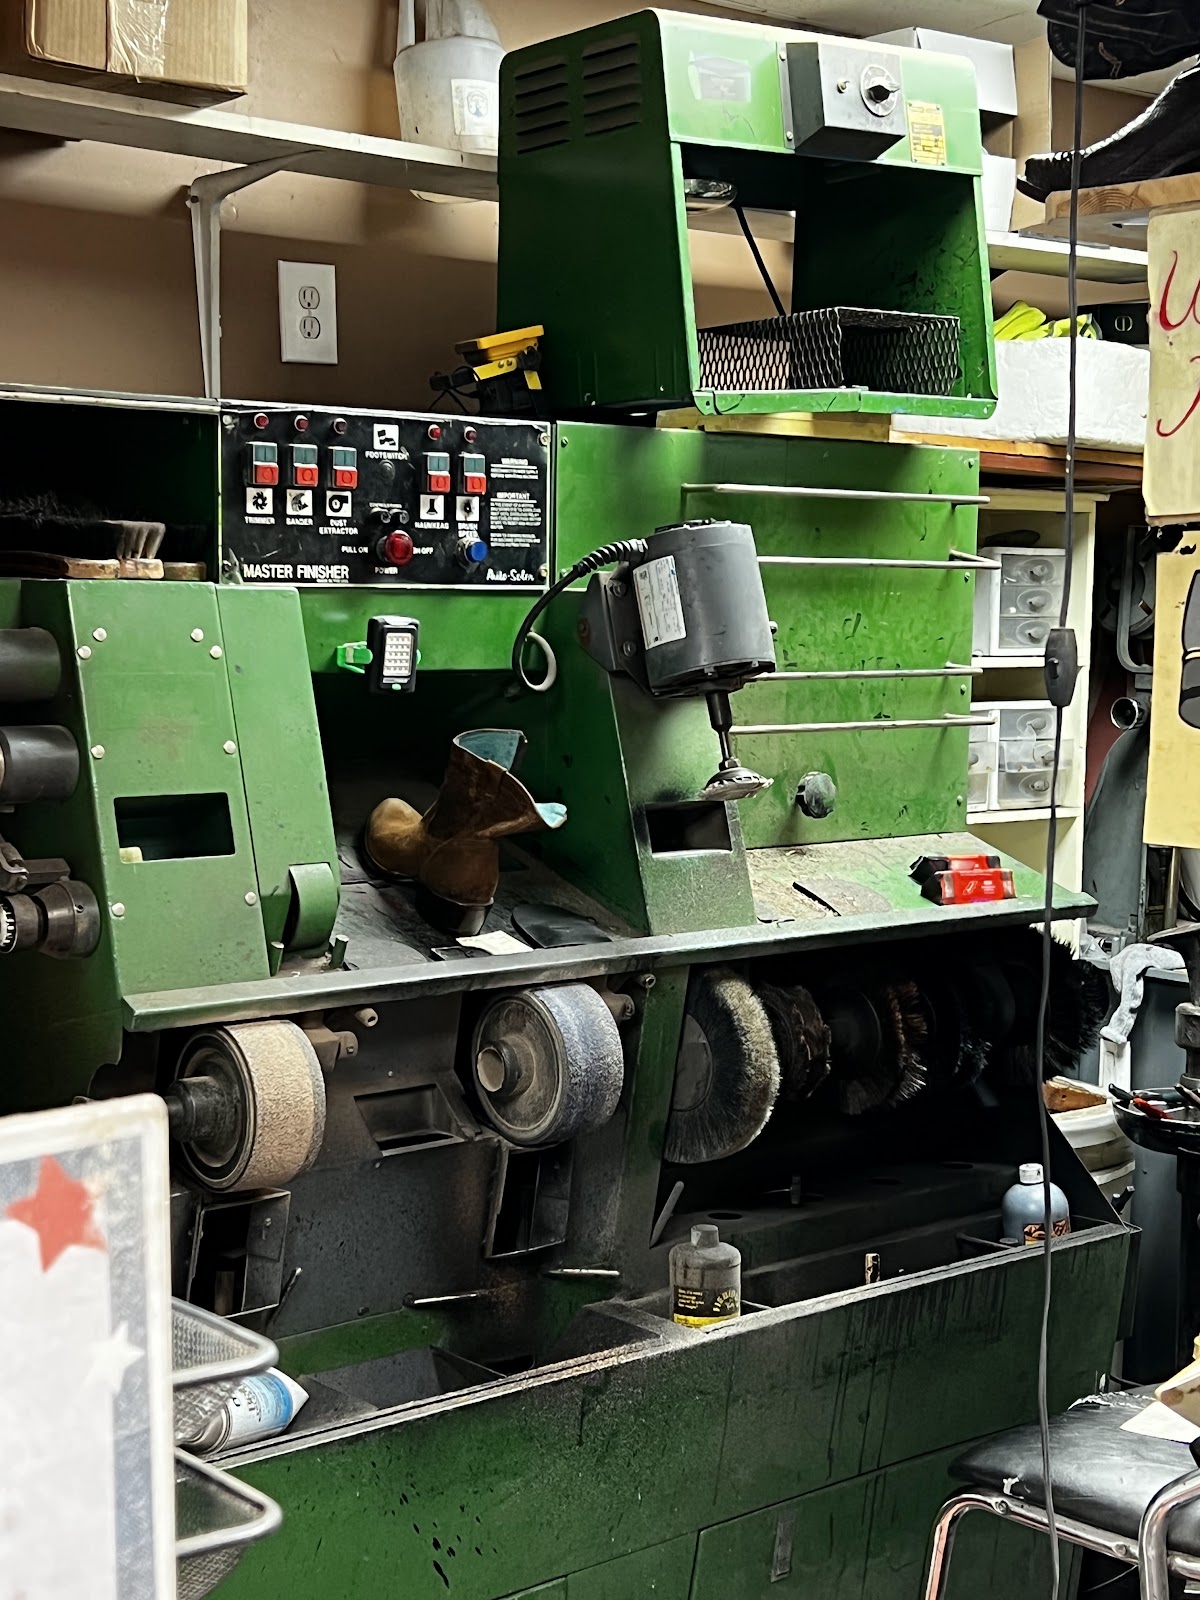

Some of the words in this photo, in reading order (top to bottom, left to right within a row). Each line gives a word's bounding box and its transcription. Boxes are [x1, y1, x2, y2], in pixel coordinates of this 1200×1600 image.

[365, 451, 409, 461] FOOTSWITCH
[496, 491, 530, 500] IMPORTANT
[244, 516, 276, 525] TRIMMER
[286, 517, 313, 526] SANDER
[330, 519, 347, 527] DUST
[319, 526, 359, 535] EXTRACTOR
[341, 545, 357, 553] PULL
[358, 546, 369, 554] ON
[243, 563, 293, 579] MASTER
[297, 564, 349, 579] FINISHER
[375, 566, 398, 575] POWER
